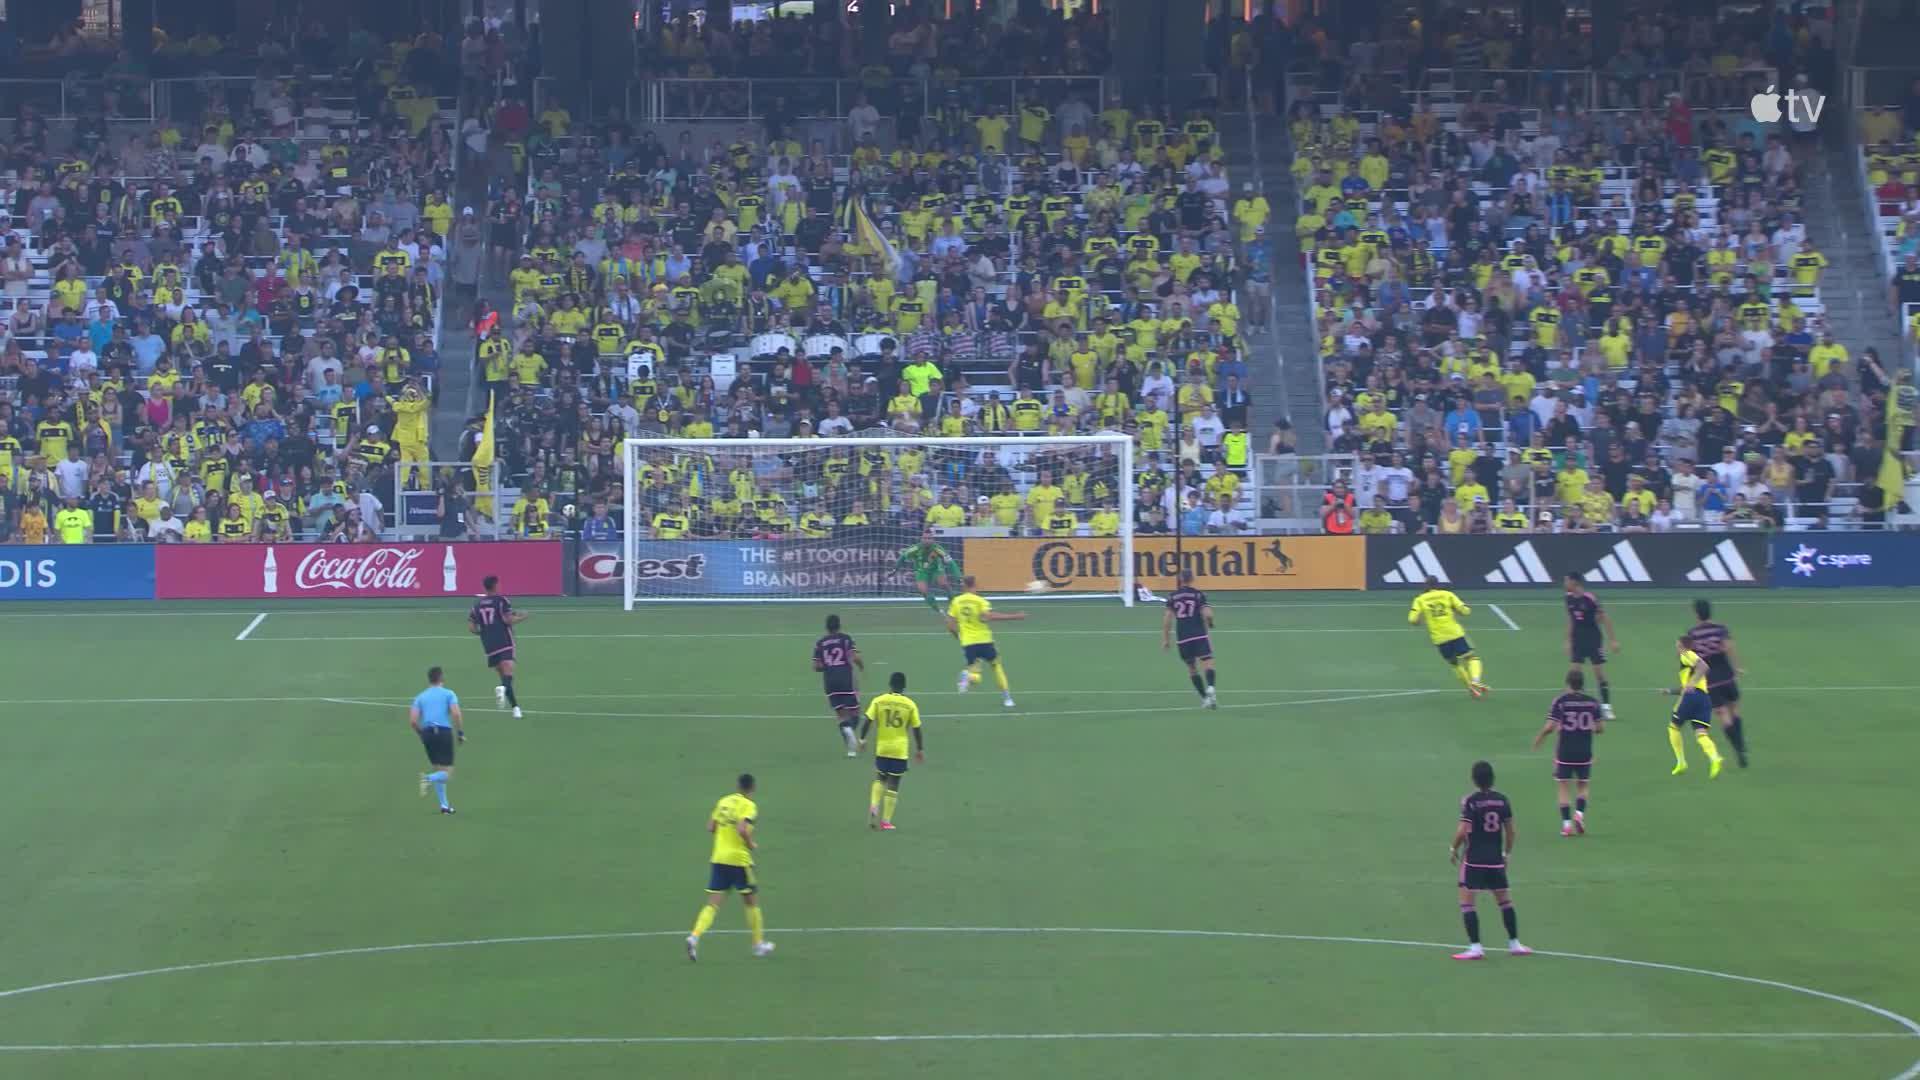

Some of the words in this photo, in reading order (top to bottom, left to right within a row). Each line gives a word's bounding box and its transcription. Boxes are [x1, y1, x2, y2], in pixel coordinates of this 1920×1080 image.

[739, 547, 777, 563] THE
[806, 548, 898, 563] TOOTHPA
[0, 559, 57, 588] DIS
[295, 548, 424, 589] Coca-Cola
[743, 570, 810, 586] BRAND
[816, 571, 836, 586] IN
[842, 571, 914, 587] AMERIC
[480, 607, 495, 625] 17
[1173, 600, 1195, 618] 27
[823, 647, 846, 666] 42
[884, 708, 903, 728] 16
[1563, 711, 1593, 731] 30
[1484, 811, 1500, 832] 8
